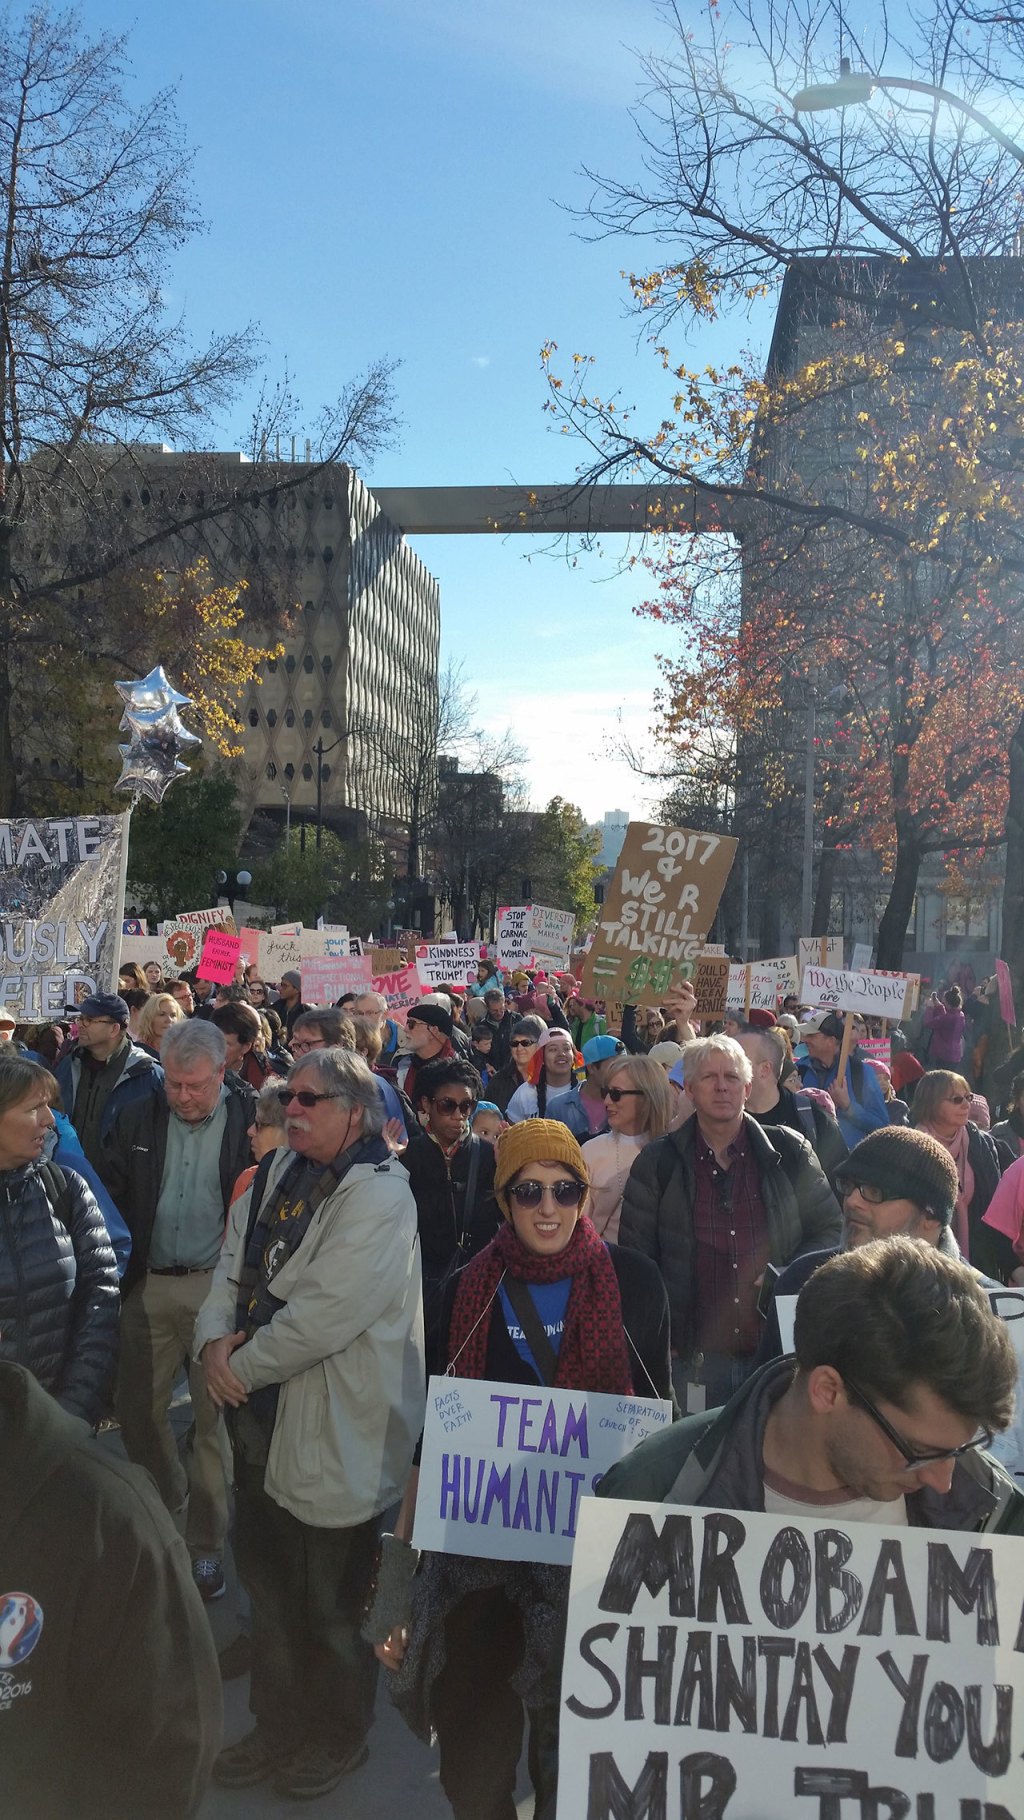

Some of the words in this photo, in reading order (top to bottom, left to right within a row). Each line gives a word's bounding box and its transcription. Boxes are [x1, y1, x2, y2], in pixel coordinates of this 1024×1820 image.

[641, 826, 720, 865] 2017
[620, 868, 666, 904] We
[677, 883, 700, 914] R
[178, 909, 225, 924] DIGNIFY
[505, 911, 527, 921] STOP
[510, 921, 525, 929] THE
[544, 921, 565, 931] WHAT
[500, 929, 528, 939] CARNAG
[537, 929, 561, 940] MAKES
[600, 920, 702, 961] TALKING
[0, 921, 109, 964] USLY
[208, 935, 240, 950] HUSBAND
[511, 939, 523, 947] ON
[801, 938, 838, 953] What
[428, 946, 476, 959] KINDNESS
[201, 957, 235, 972] FEMINIST
[439, 959, 479, 969] TRUMPS
[697, 964, 728, 977] OULD
[371, 971, 413, 994] OVE
[426, 970, 463, 981] TRUMP!
[696, 977, 723, 988] HAVE
[694, 987, 725, 998] BEEN
[809, 970, 833, 990] We
[855, 975, 905, 1002] People
[387, 996, 420, 1011] MERICA
[751, 991, 776, 1008] Right!
[819, 991, 841, 1003] are
[507, 1325, 527, 1340] TEA
[434, 1389, 460, 1412] FACTS
[439, 1402, 465, 1420] OVER
[616, 1401, 668, 1424] SEPARATION
[443, 1409, 473, 1433] FAITH
[490, 1394, 590, 1459] TEAM
[628, 1416, 642, 1427] OF
[597, 1512, 752, 1625] MR
[759, 1526, 1024, 1653] OBAM
[564, 1622, 861, 1749] SHANTAY
[875, 1649, 1015, 1779] YOU
